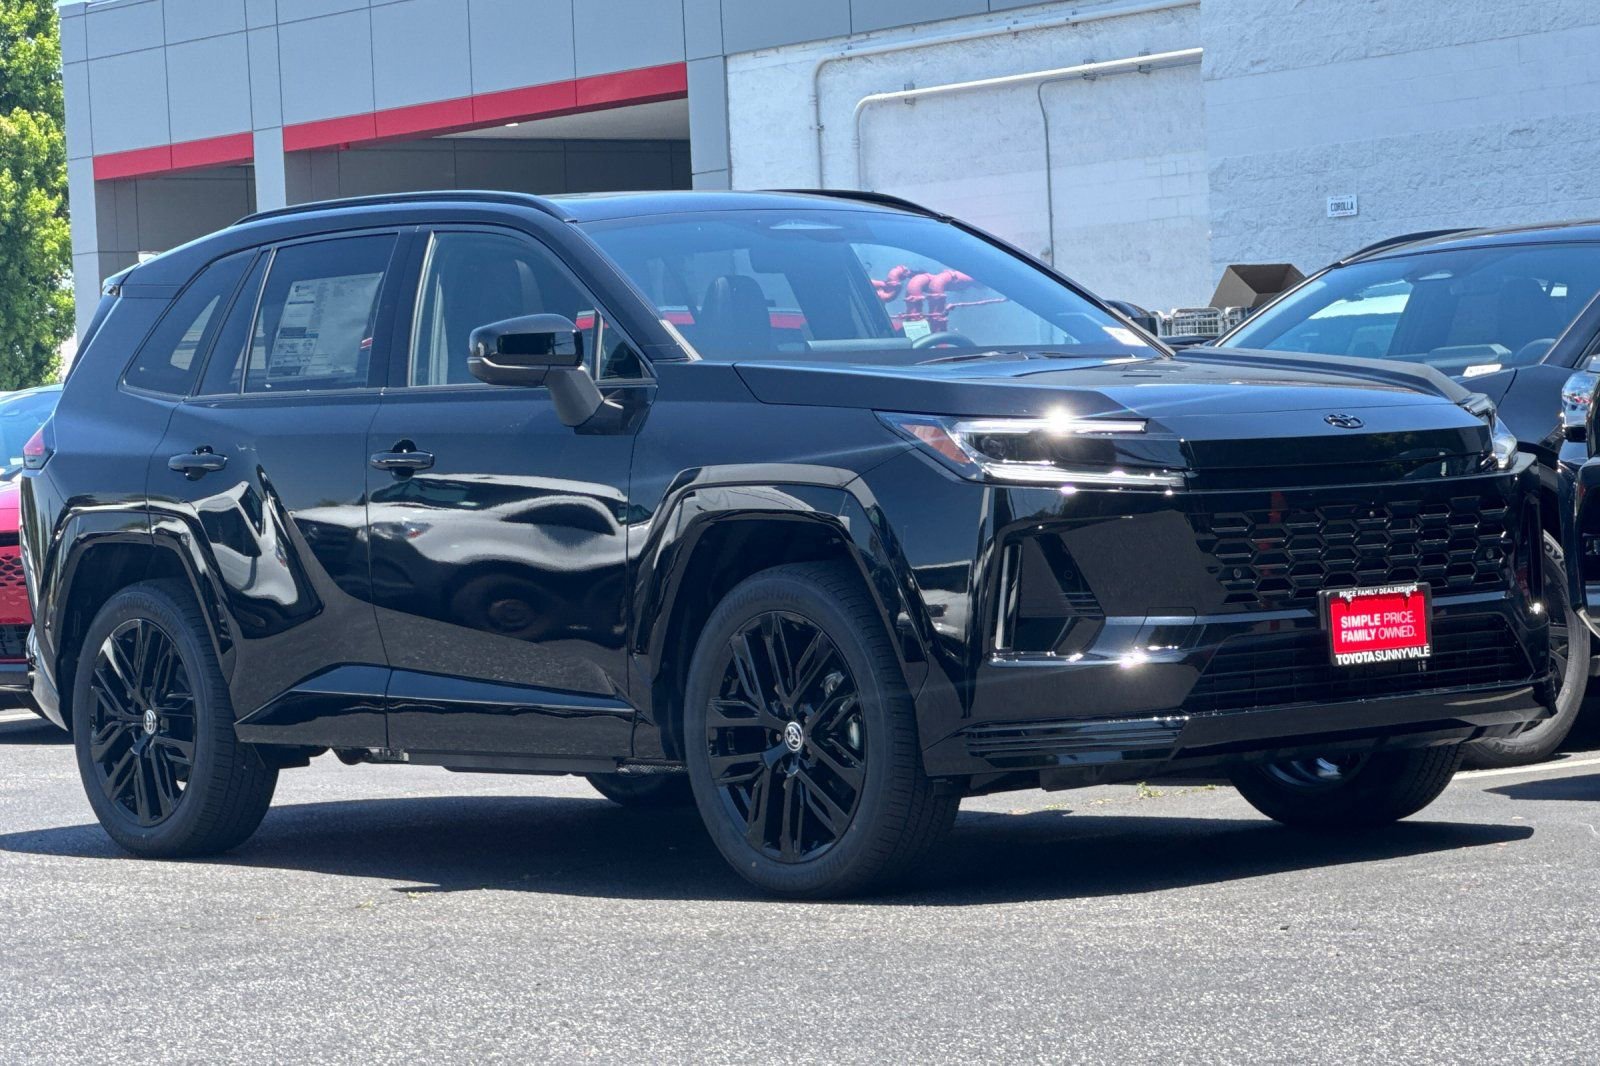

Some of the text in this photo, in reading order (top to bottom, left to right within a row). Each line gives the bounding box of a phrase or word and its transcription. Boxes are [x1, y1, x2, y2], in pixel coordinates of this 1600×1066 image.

[1331, 202, 1354, 211] COROLLA
[1357, 588, 1378, 597] FAMILY
[1379, 585, 1418, 595] DEALERSHIPS
[1341, 611, 1415, 628] SIMPLE PRICE.
[1341, 626, 1416, 643] FAMILY OWNED.
